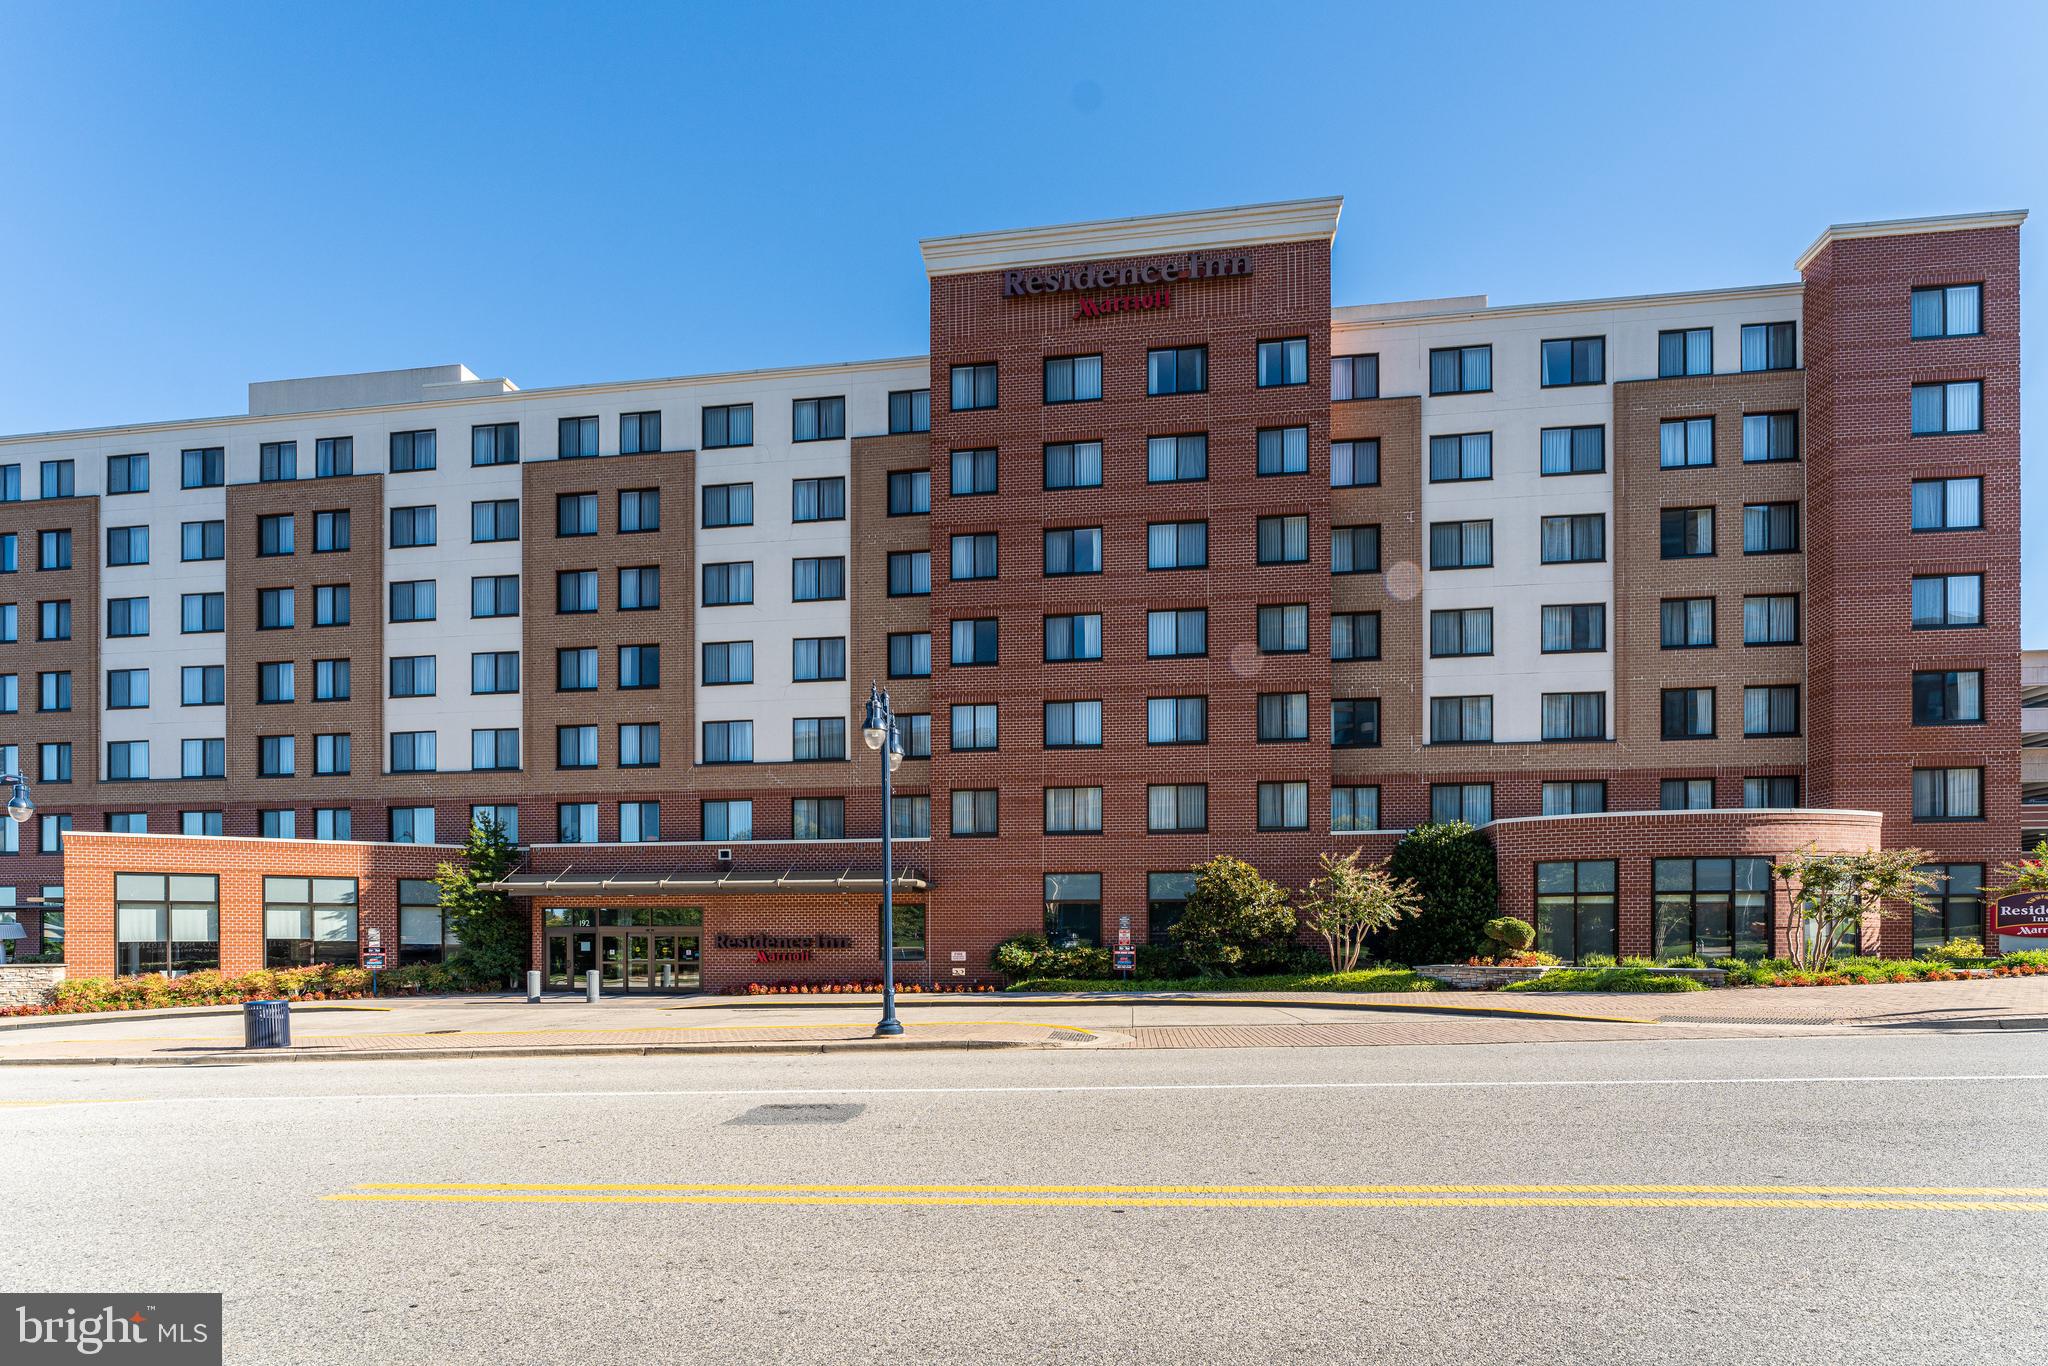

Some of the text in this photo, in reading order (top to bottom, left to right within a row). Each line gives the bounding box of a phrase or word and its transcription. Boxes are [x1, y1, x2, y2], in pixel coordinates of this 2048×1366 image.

[1003, 252, 1252, 298] Residence Inn
[1073, 288, 1170, 320] Marriott
[2001, 905, 2048, 915] Resid
[579, 919, 591, 927] 192
[715, 933, 851, 949] Residence Inn
[752, 949, 809, 964] Marriott
